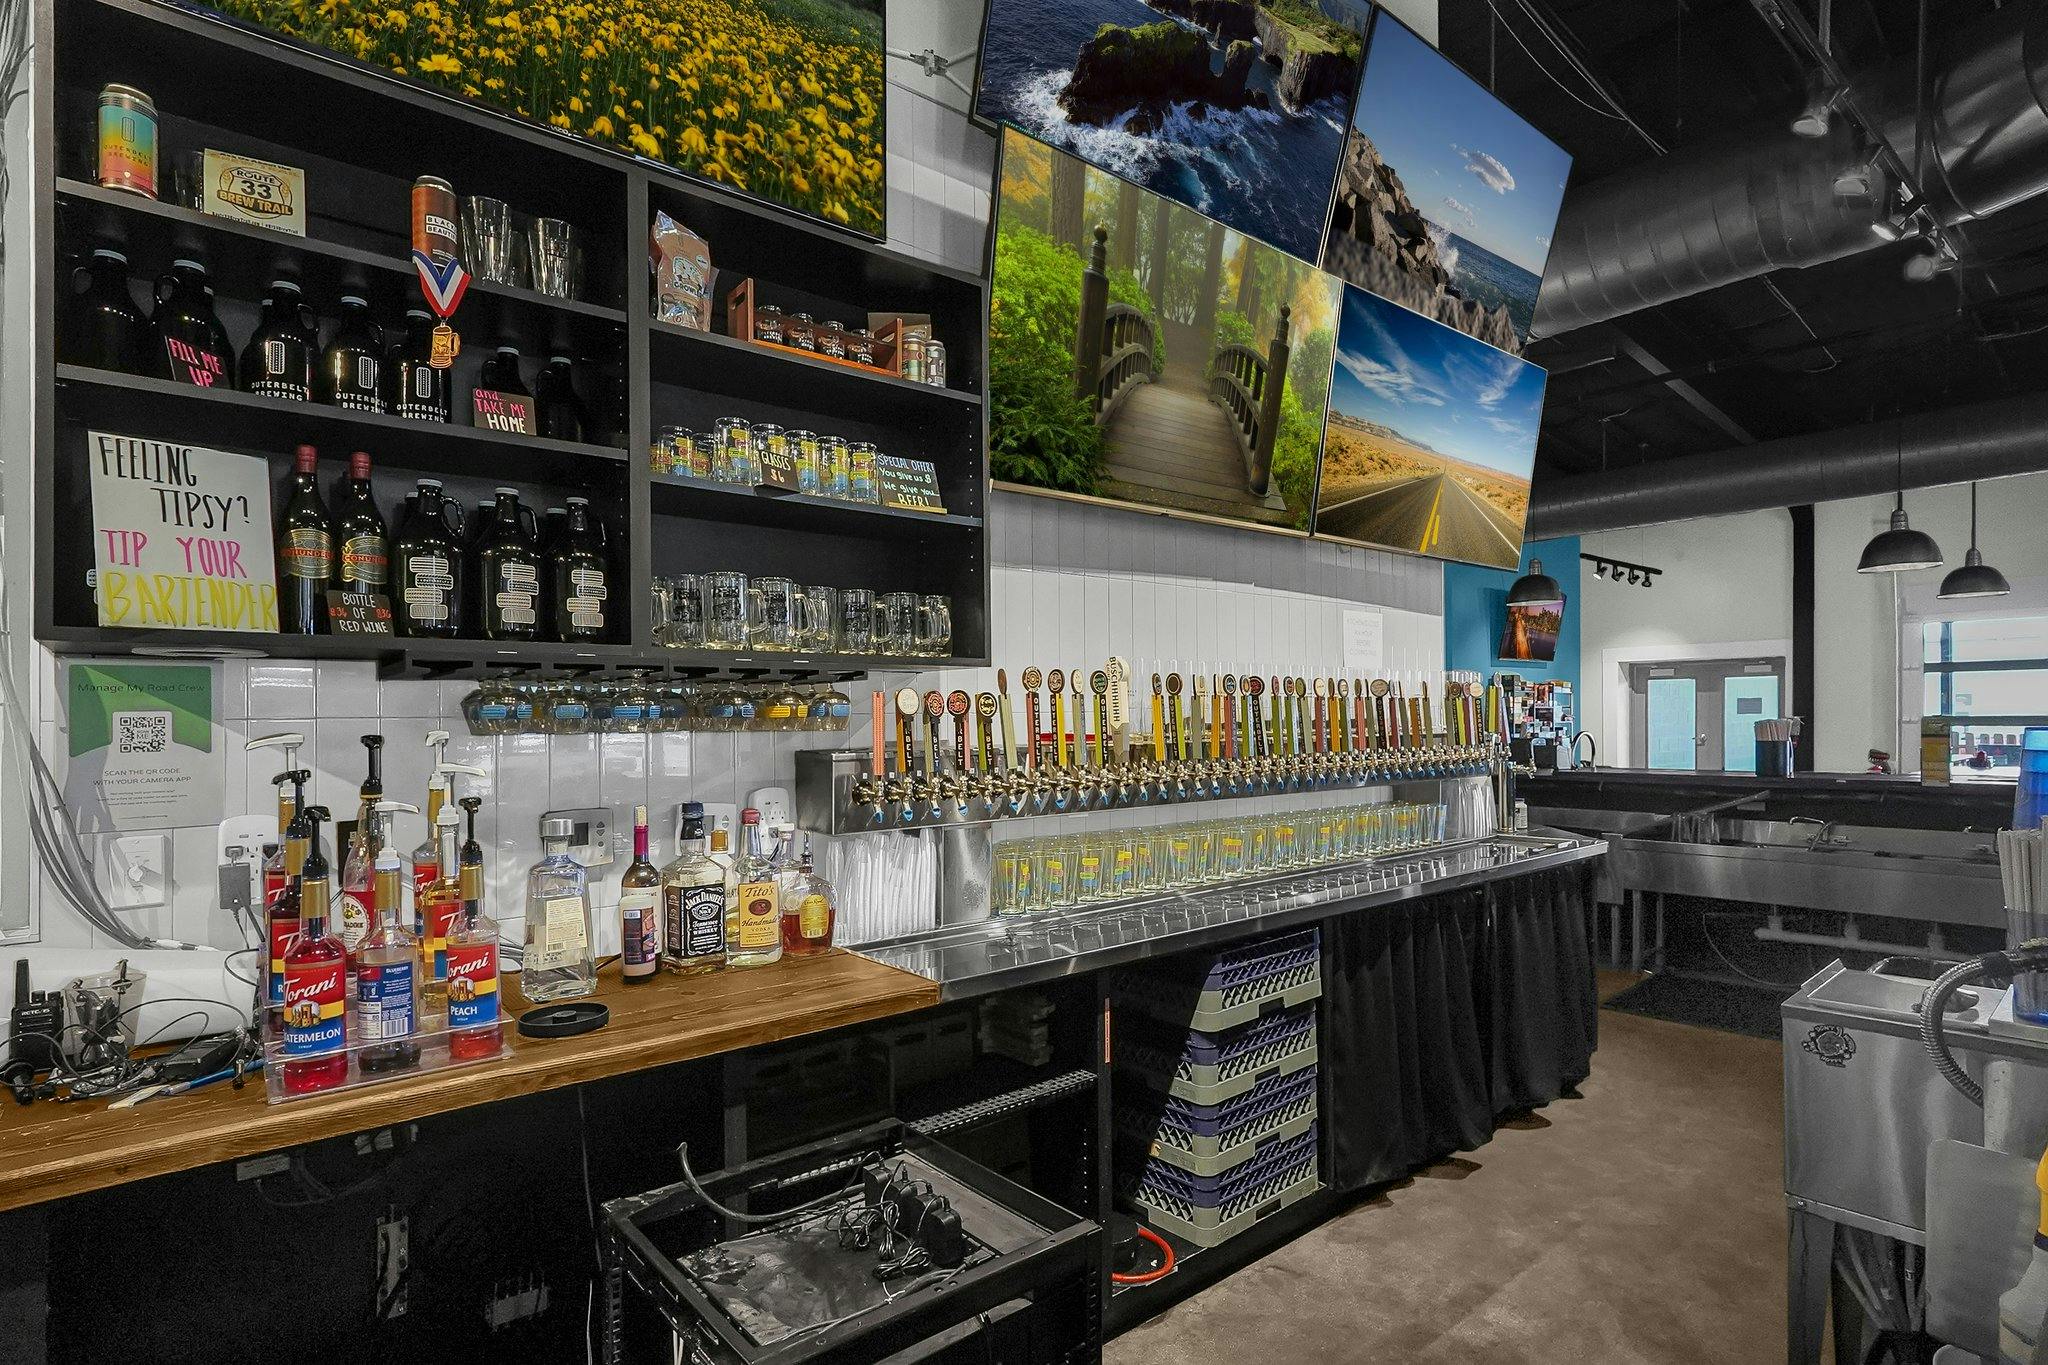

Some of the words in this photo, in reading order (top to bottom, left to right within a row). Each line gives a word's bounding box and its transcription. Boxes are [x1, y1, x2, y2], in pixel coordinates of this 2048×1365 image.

[236, 169, 276, 183] ROUTE
[240, 179, 273, 199] 33
[220, 190, 256, 208] BREW
[257, 199, 292, 215] TRAIL
[168, 337, 201, 366] FILL
[200, 350, 223, 375] ME
[188, 365, 214, 387] UP
[251, 380, 309, 394] OUTERBELT
[255, 390, 303, 402] BREWING
[396, 403, 448, 416] OUTERBELT
[402, 412, 445, 423] BREWING
[475, 398, 504, 414] TAKE
[510, 403, 526, 418] ME
[486, 412, 526, 434] HOME
[97, 436, 197, 487] FEELING
[760, 450, 792, 472] GLASSES
[150, 487, 250, 532] TIPSY?
[100, 529, 148, 568] TIP
[175, 536, 248, 579] YOUR
[103, 572, 278, 632] BARTENDER
[342, 592, 376, 608] BOTTLE
[352, 606, 366, 620] OF
[339, 619, 361, 632] RED
[361, 620, 389, 633] WINE
[77, 683, 124, 694] Manage
[127, 684, 144, 694] My
[147, 683, 175, 692] Road
[178, 684, 205, 692] Crew
[1033, 697, 1041, 763] OUTERBELT
[1100, 697, 1108, 760] OUTERBELT
[1252, 700, 1263, 753] OUTERBELT
[92, 779, 115, 787] WITH
[115, 777, 139, 786] YOUR
[140, 776, 174, 785] CAMERA
[175, 775, 192, 783] APP
[104, 769, 127, 777] SCAN
[128, 768, 144, 776] THE
[145, 768, 158, 776] QR
[158, 767, 181, 775] CODE
[744, 885, 775, 898] Tito's
[685, 894, 702, 910] JACK
[692, 927, 718, 935] WHISKEY
[446, 951, 490, 979] Torani
[284, 971, 337, 1009] Torani
[450, 1005, 478, 1016] PEACH
